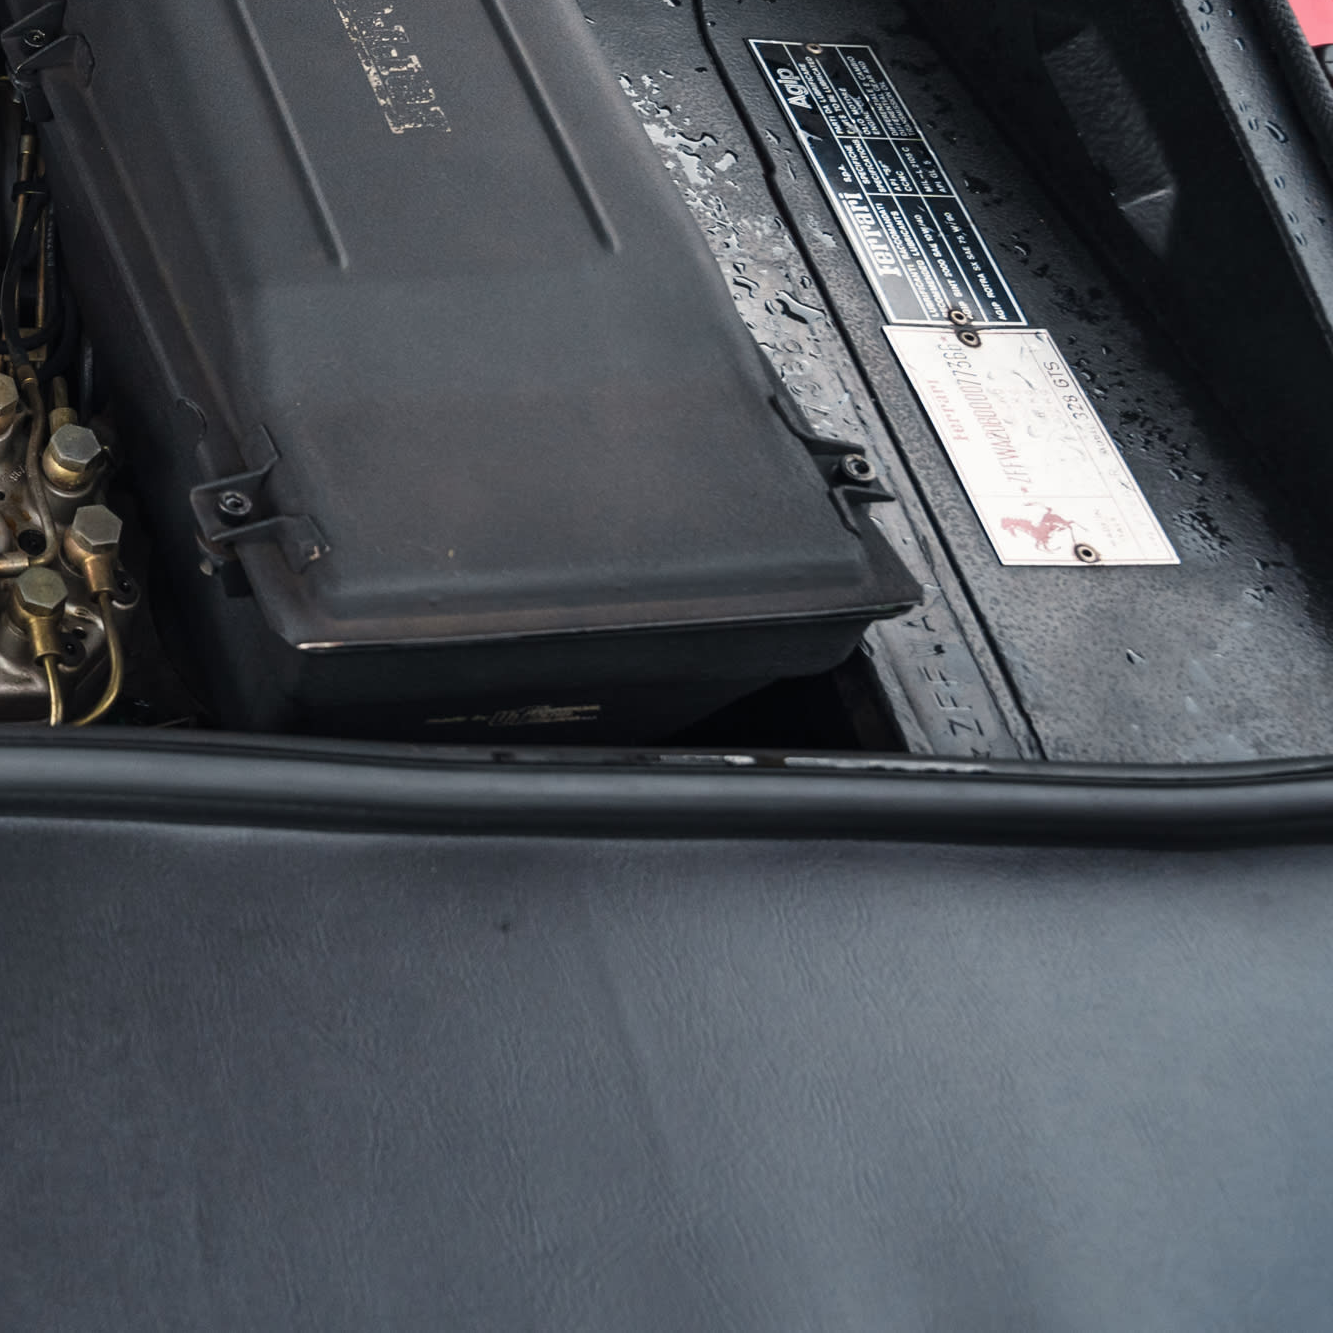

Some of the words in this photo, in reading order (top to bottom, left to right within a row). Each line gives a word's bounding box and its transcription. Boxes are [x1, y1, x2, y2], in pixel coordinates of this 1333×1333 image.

[770, 67, 816, 109] Agip
[843, 145, 871, 184] SPECIFICHE
[850, 139, 887, 192] SPECIFICATIONS
[894, 170, 913, 191] CCMC
[888, 178, 902, 191] API
[933, 181, 947, 192] API
[836, 192, 903, 276] Ferrari
[889, 210, 921, 256] LUBRICANTS
[990, 301, 1008, 319] AGIP
[1040, 361, 1071, 387] GTS
[926, 379, 969, 441] Ferrari
[1059, 394, 1090, 419] 328
